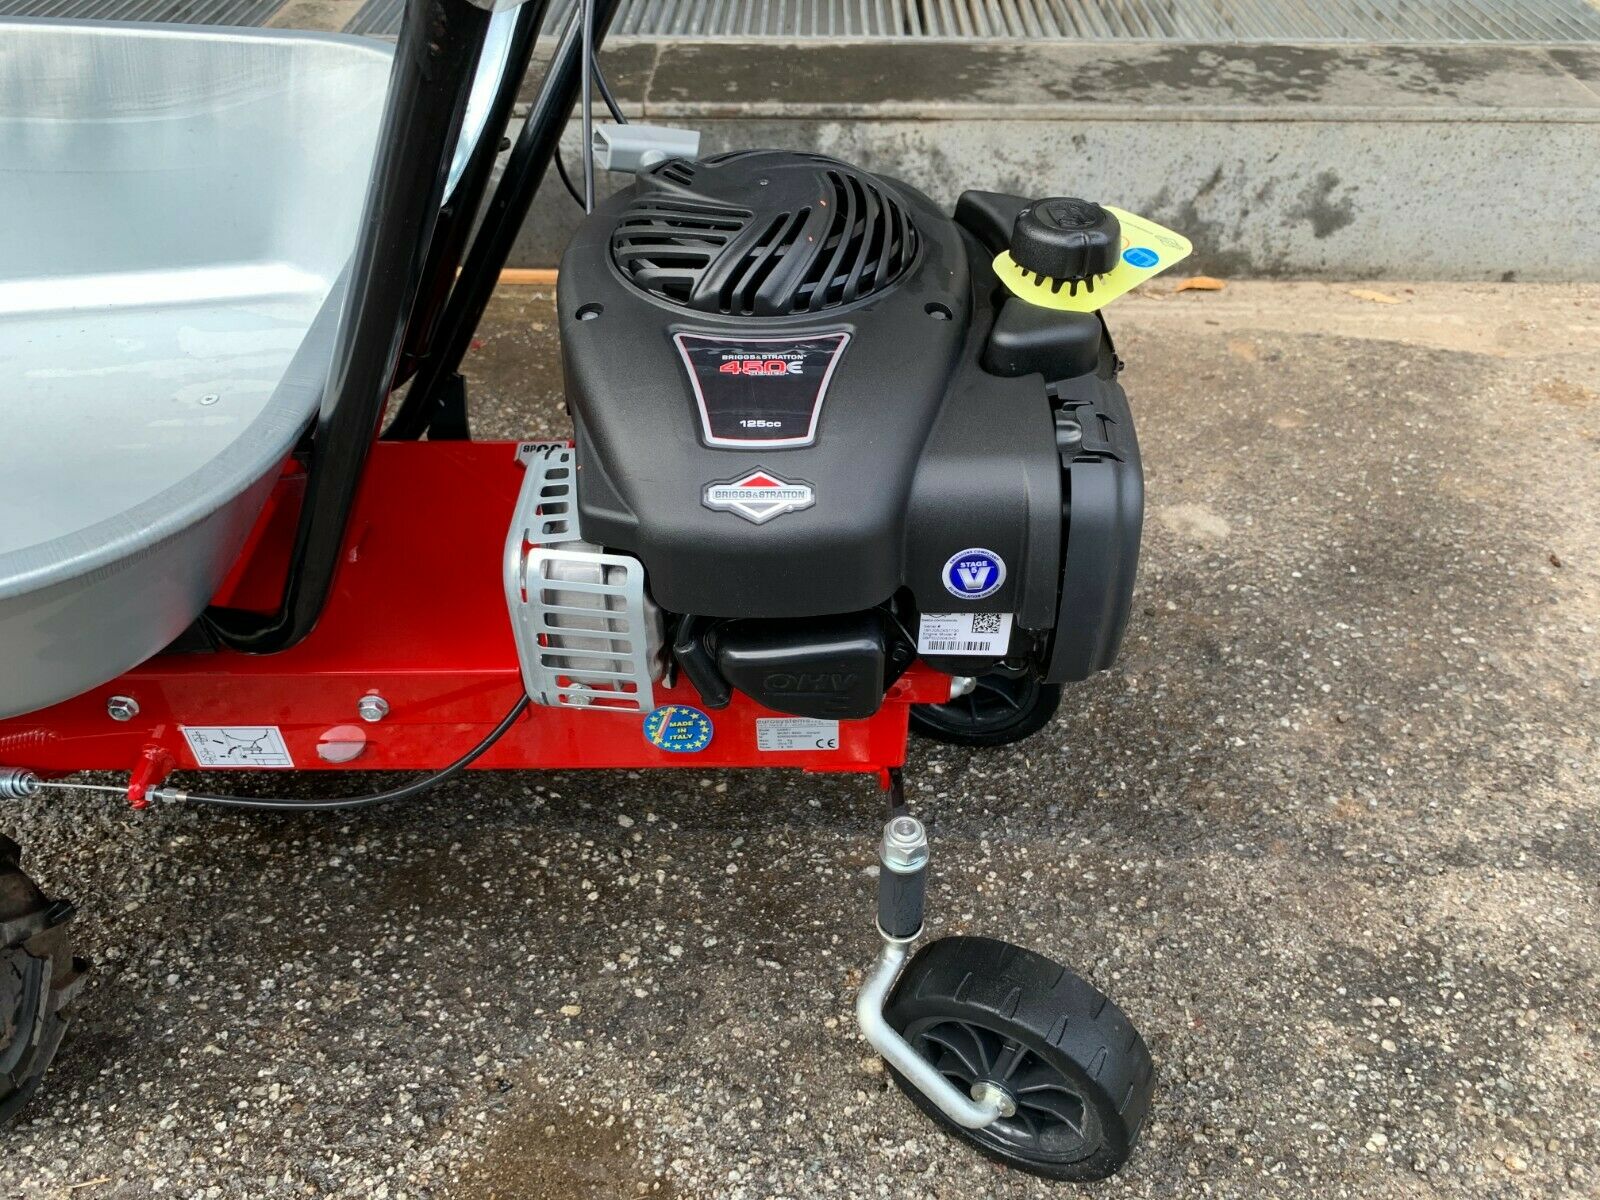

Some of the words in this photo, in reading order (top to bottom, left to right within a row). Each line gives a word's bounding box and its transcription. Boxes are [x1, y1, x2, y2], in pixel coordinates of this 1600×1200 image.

[739, 420, 782, 428] 125cc
[714, 490, 805, 499] BRIGGS&STRATTON
[959, 560, 988, 568] STAGE
[669, 720, 694, 728] MADE
[669, 733, 693, 741] ITALY
